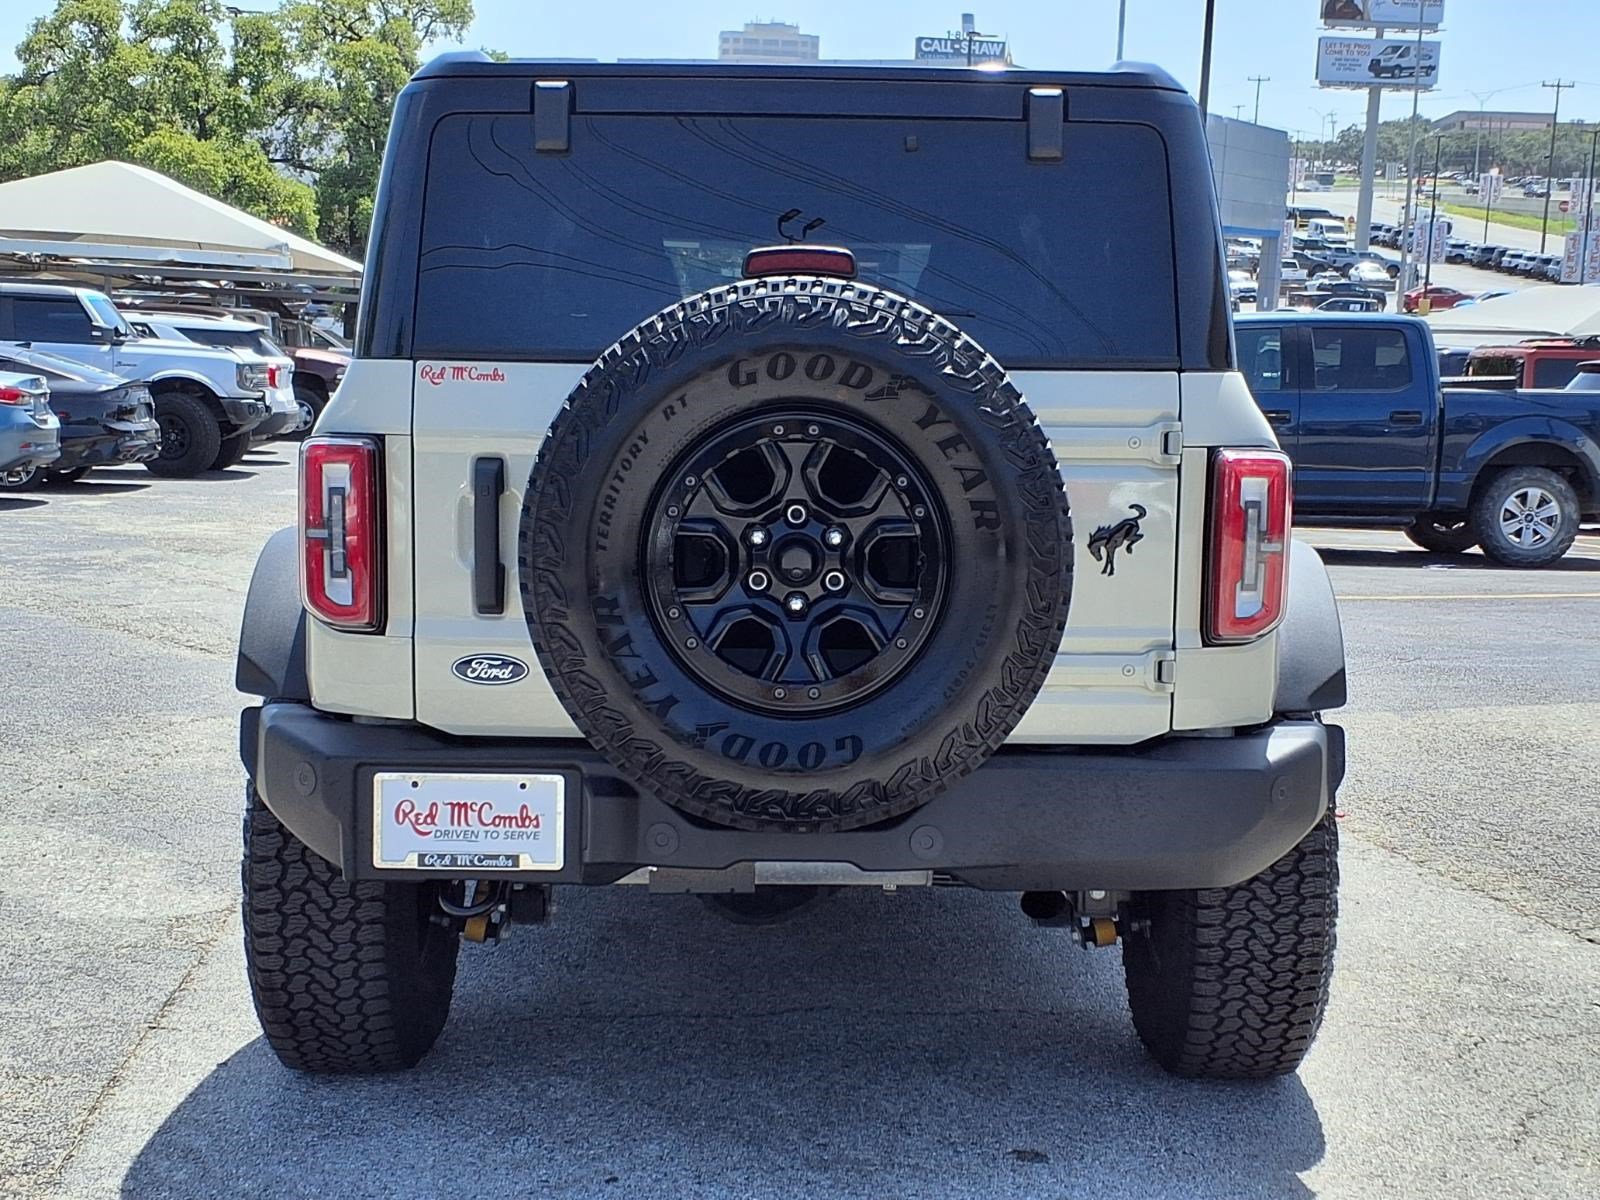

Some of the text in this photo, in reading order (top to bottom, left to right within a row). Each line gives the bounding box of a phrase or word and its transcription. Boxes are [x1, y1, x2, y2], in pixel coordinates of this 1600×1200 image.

[420, 364, 505, 385] Red McCombs
[595, 393, 688, 552] TERRITORY RT
[466, 659, 514, 679] Ford
[394, 799, 541, 837] Red McCombs
[433, 829, 541, 842] DRIVEN TO SERVE
[424, 854, 513, 868] Red McCombs
